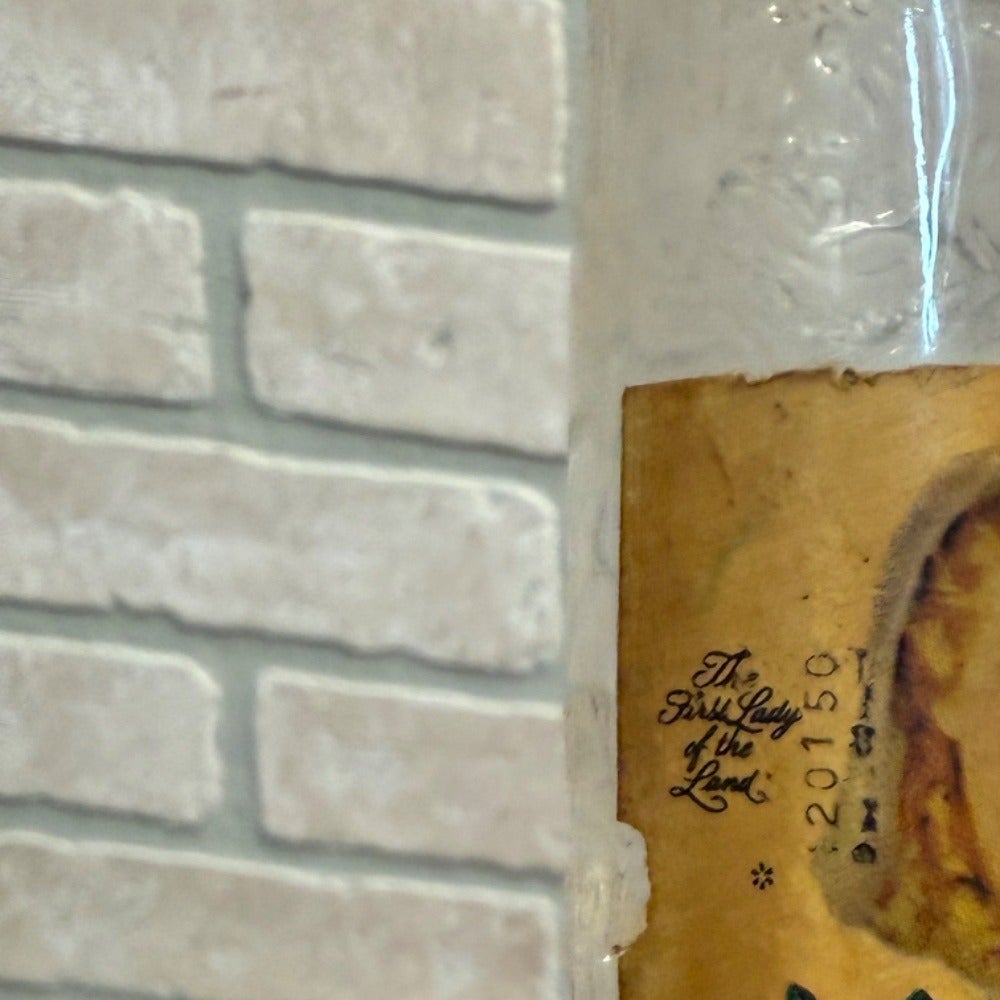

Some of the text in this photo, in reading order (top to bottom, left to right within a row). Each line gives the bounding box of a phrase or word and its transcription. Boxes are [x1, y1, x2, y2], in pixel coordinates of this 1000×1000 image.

[692, 648, 759, 689] The
[658, 686, 803, 740] First Lady
[684, 725, 754, 773] of the
